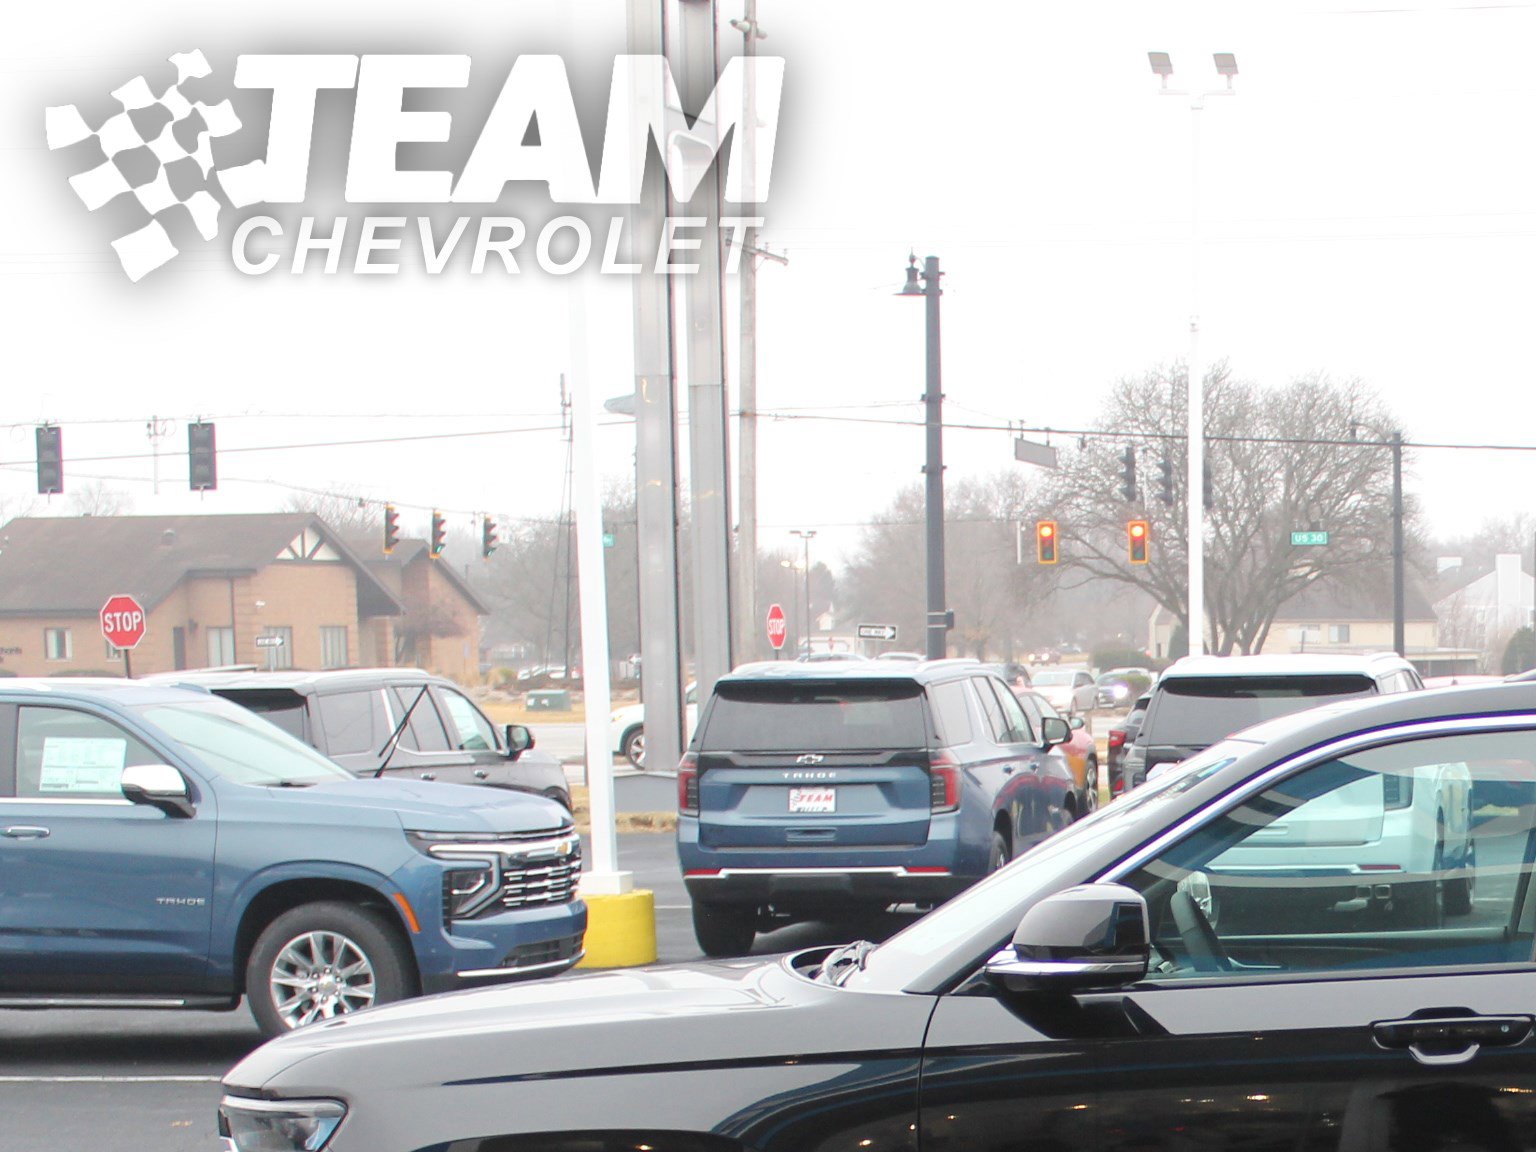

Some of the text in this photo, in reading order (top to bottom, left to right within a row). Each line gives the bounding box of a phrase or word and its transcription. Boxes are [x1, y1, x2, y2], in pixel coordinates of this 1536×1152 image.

[1295, 533, 1323, 542] US 30
[104, 611, 141, 633] STOP
[769, 619, 785, 634] STOP
[799, 793, 834, 802] TEAM
[156, 897, 206, 906] TAHOE
